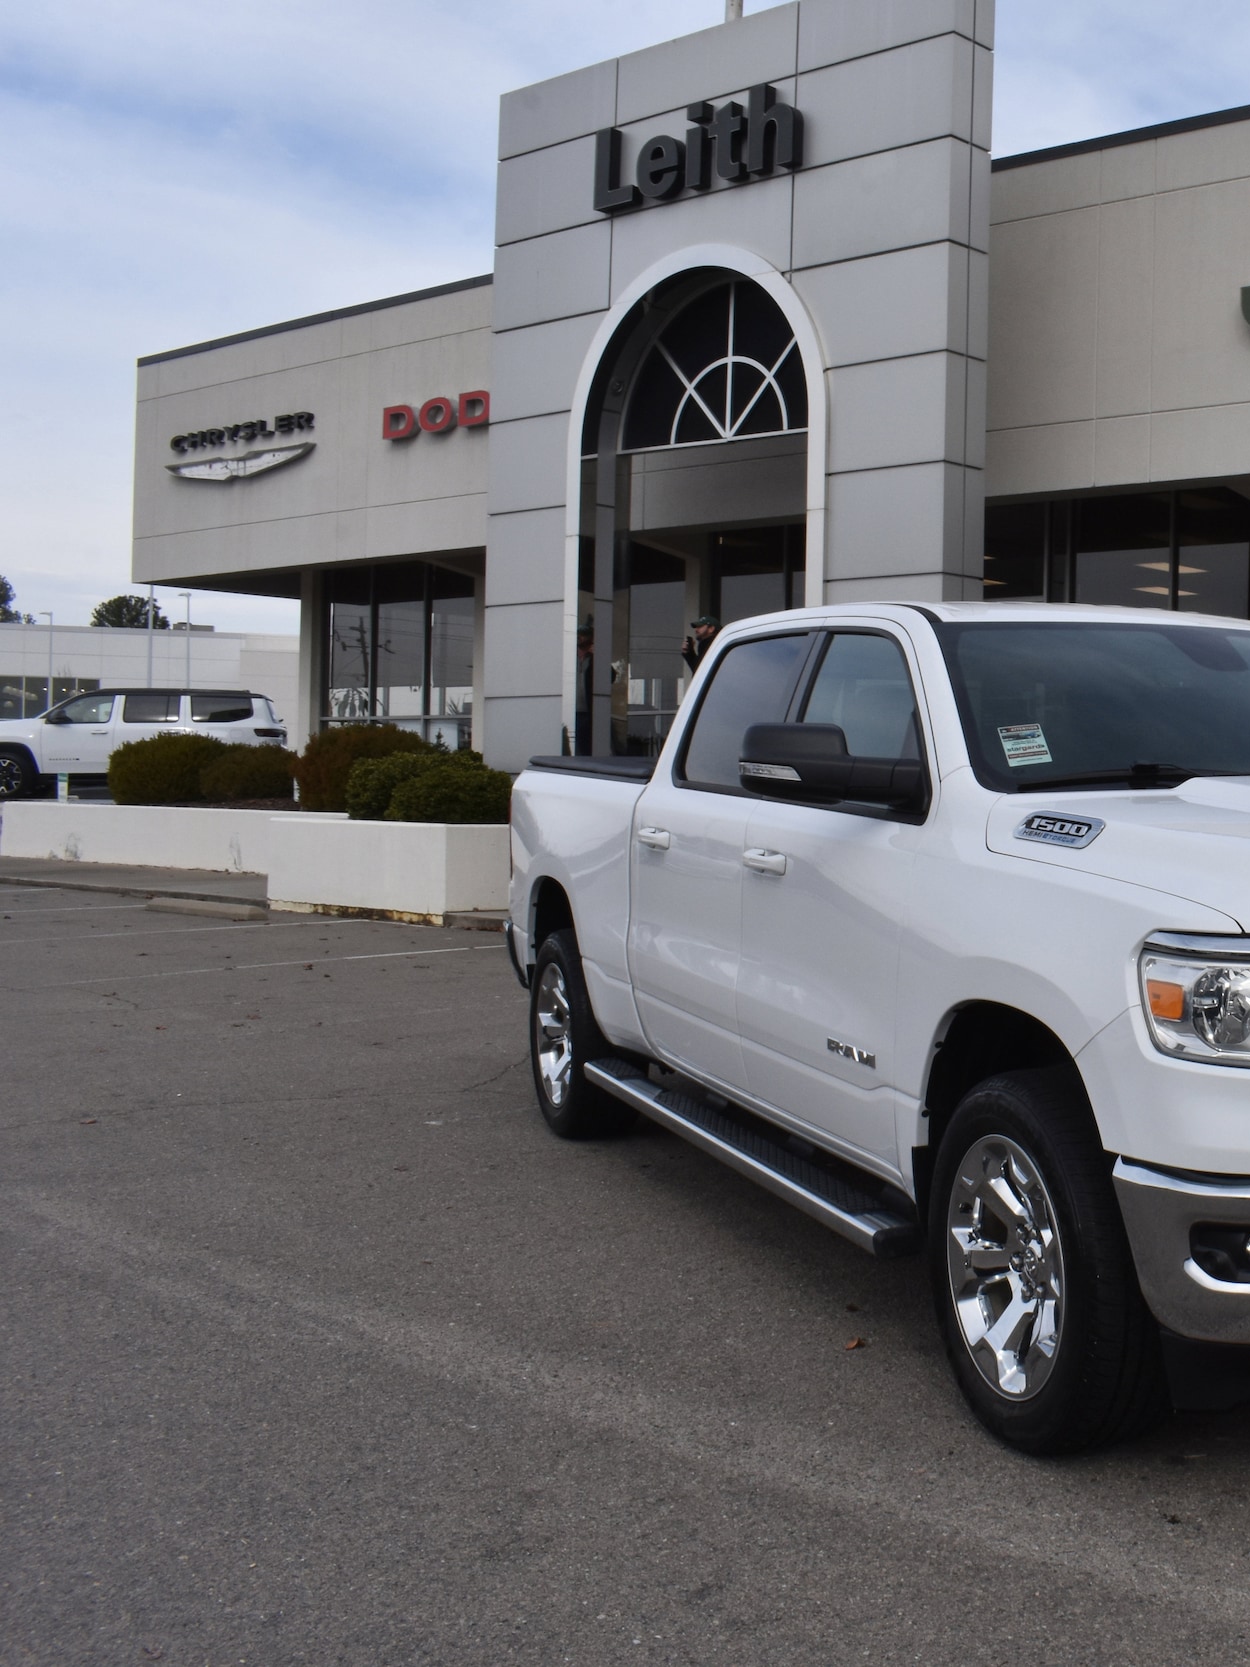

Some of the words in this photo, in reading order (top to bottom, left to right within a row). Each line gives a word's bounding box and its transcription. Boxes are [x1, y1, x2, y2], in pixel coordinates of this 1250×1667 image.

[593, 82, 804, 214] Leith
[170, 411, 315, 453] CHRYSLER
[1022, 829, 1043, 838] HEMI
[1030, 817, 1089, 837] 1500
[827, 1036, 876, 1069] RAM
